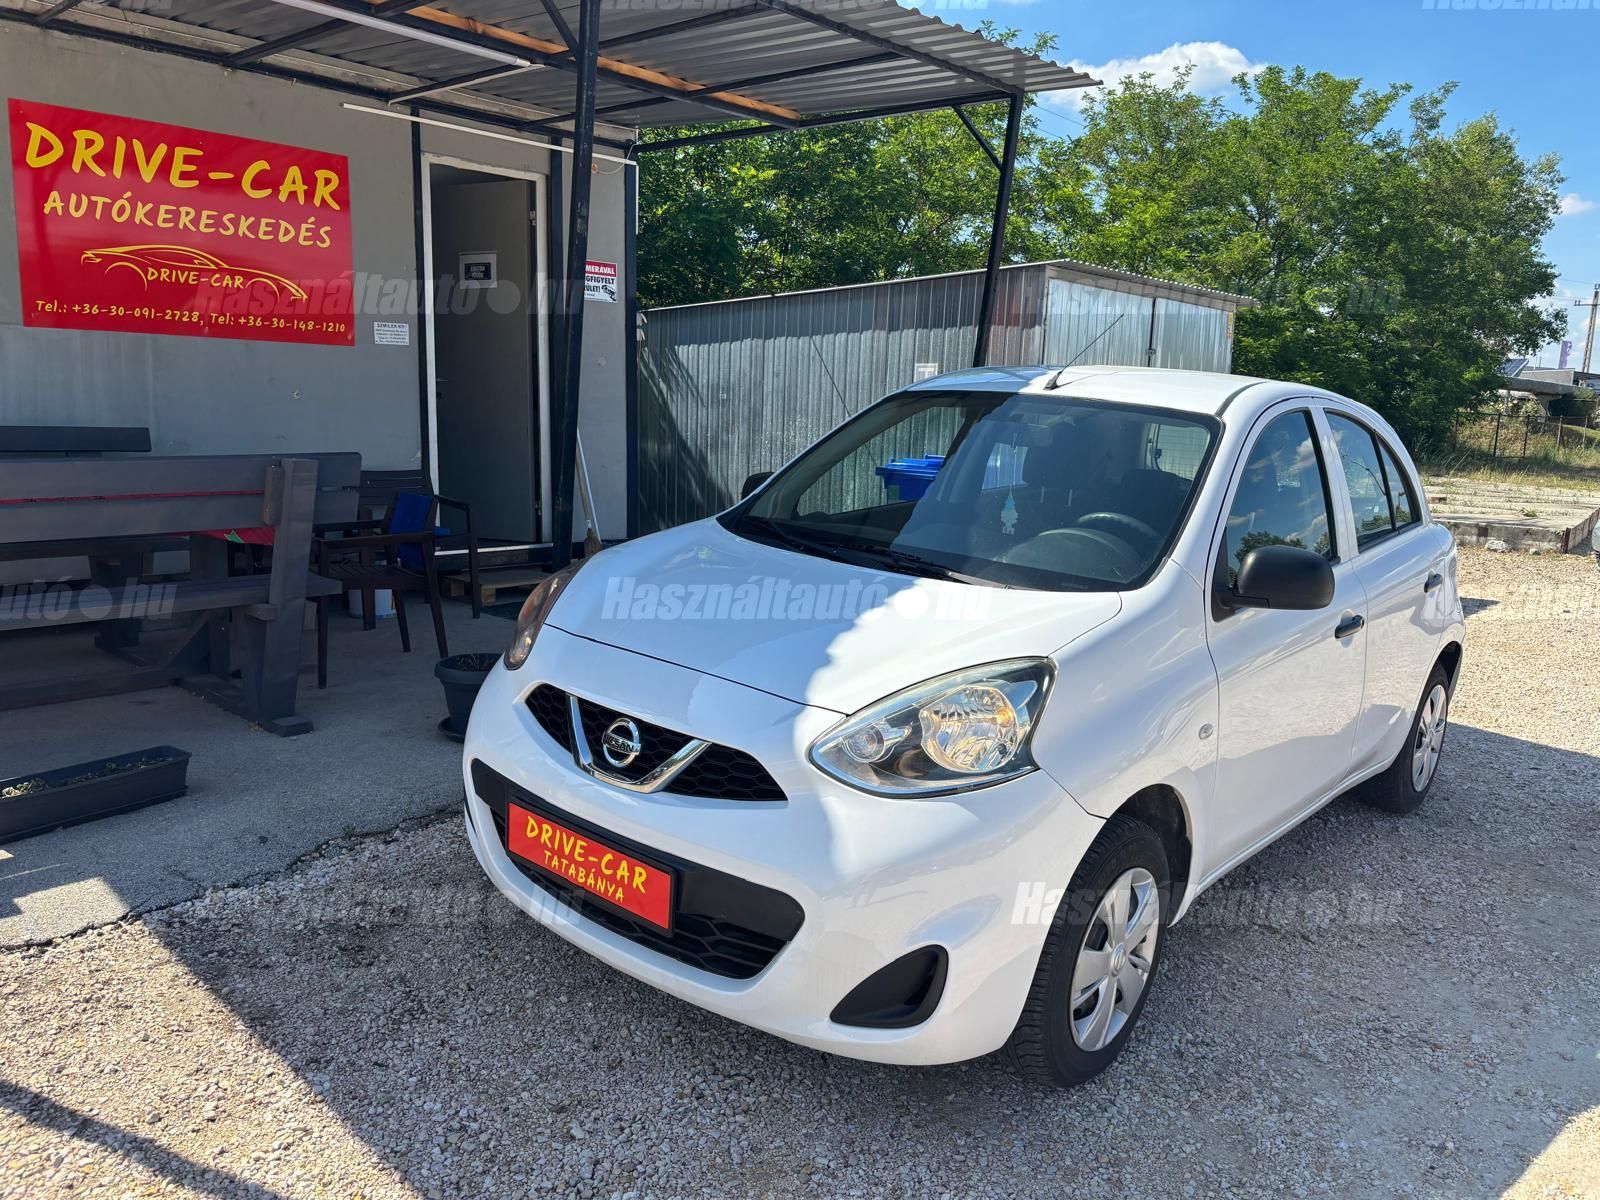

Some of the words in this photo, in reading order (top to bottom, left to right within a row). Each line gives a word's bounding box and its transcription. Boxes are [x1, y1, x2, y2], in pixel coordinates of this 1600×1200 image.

[26, 121, 341, 211] DRIVE-CAR
[43, 190, 332, 248] AUTÓKERESKEDÉS
[147, 267, 244, 289] DRIVE-CAR
[585, 264, 616, 276] MERÁVAL
[585, 275, 615, 285] GFIGYELT
[35, 300, 68, 314] Tel.:
[72, 301, 204, 327] +36-30-091-2728,
[210, 313, 234, 326] Tel:
[238, 315, 346, 333] +36-30-148-1210
[604, 734, 635, 753] NISSAN
[526, 815, 647, 893] DRIVE-CAR
[544, 850, 625, 903] TATABÁNYA
